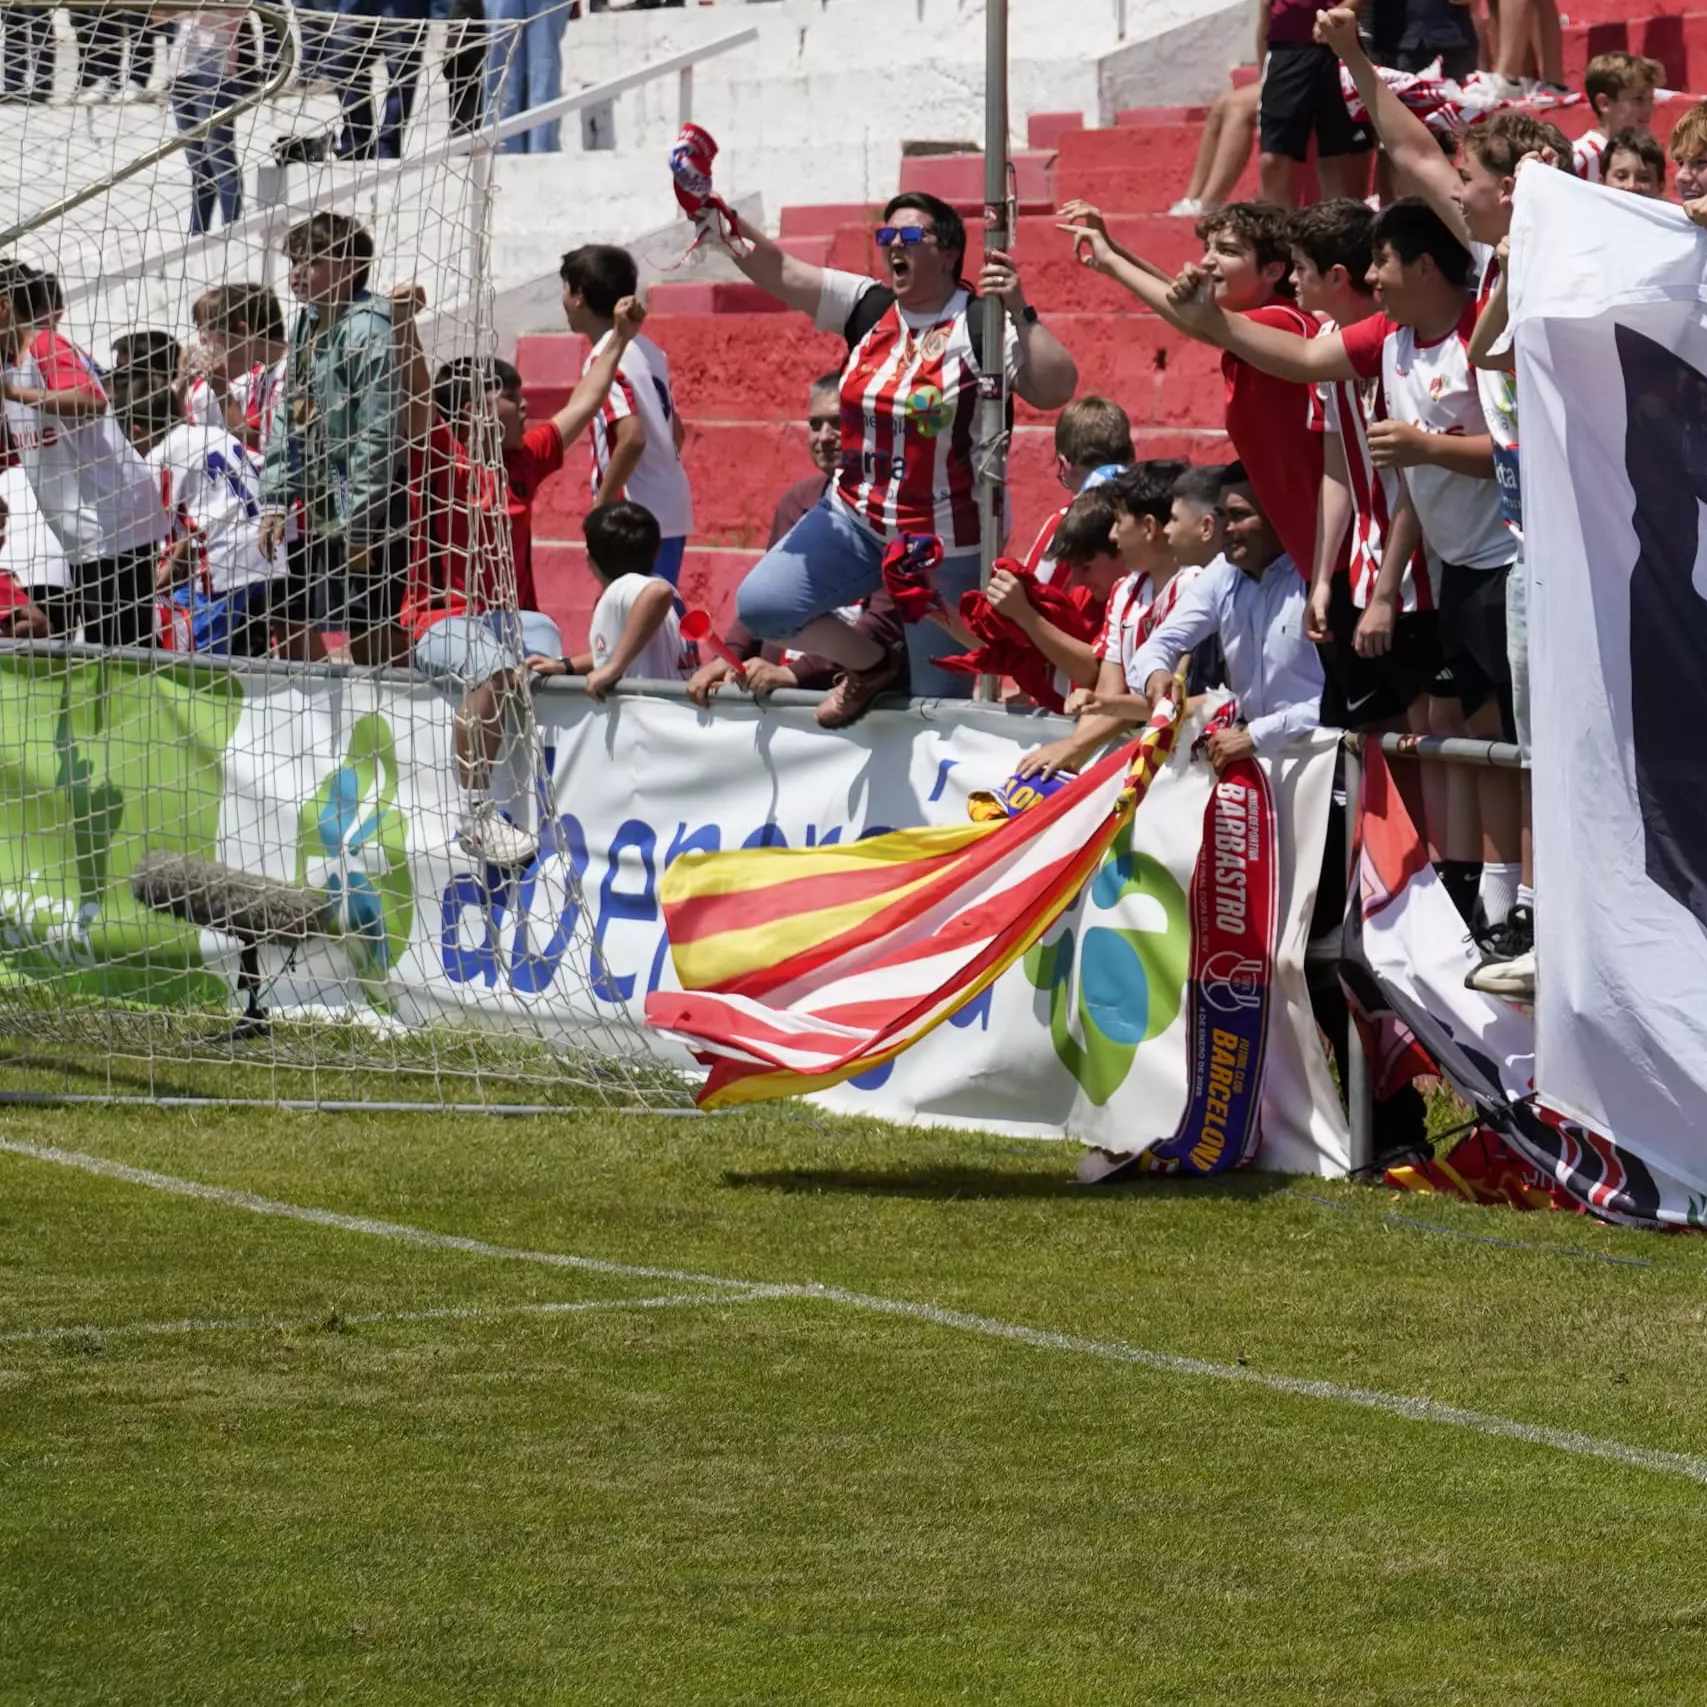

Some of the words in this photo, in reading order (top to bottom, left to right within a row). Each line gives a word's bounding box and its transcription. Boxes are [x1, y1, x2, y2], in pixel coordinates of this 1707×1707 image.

[1214, 782, 1247, 935] BARBASTRO
[1248, 815, 1259, 861] DEPORTIVA
[1198, 1025, 1206, 1059] ENERO
